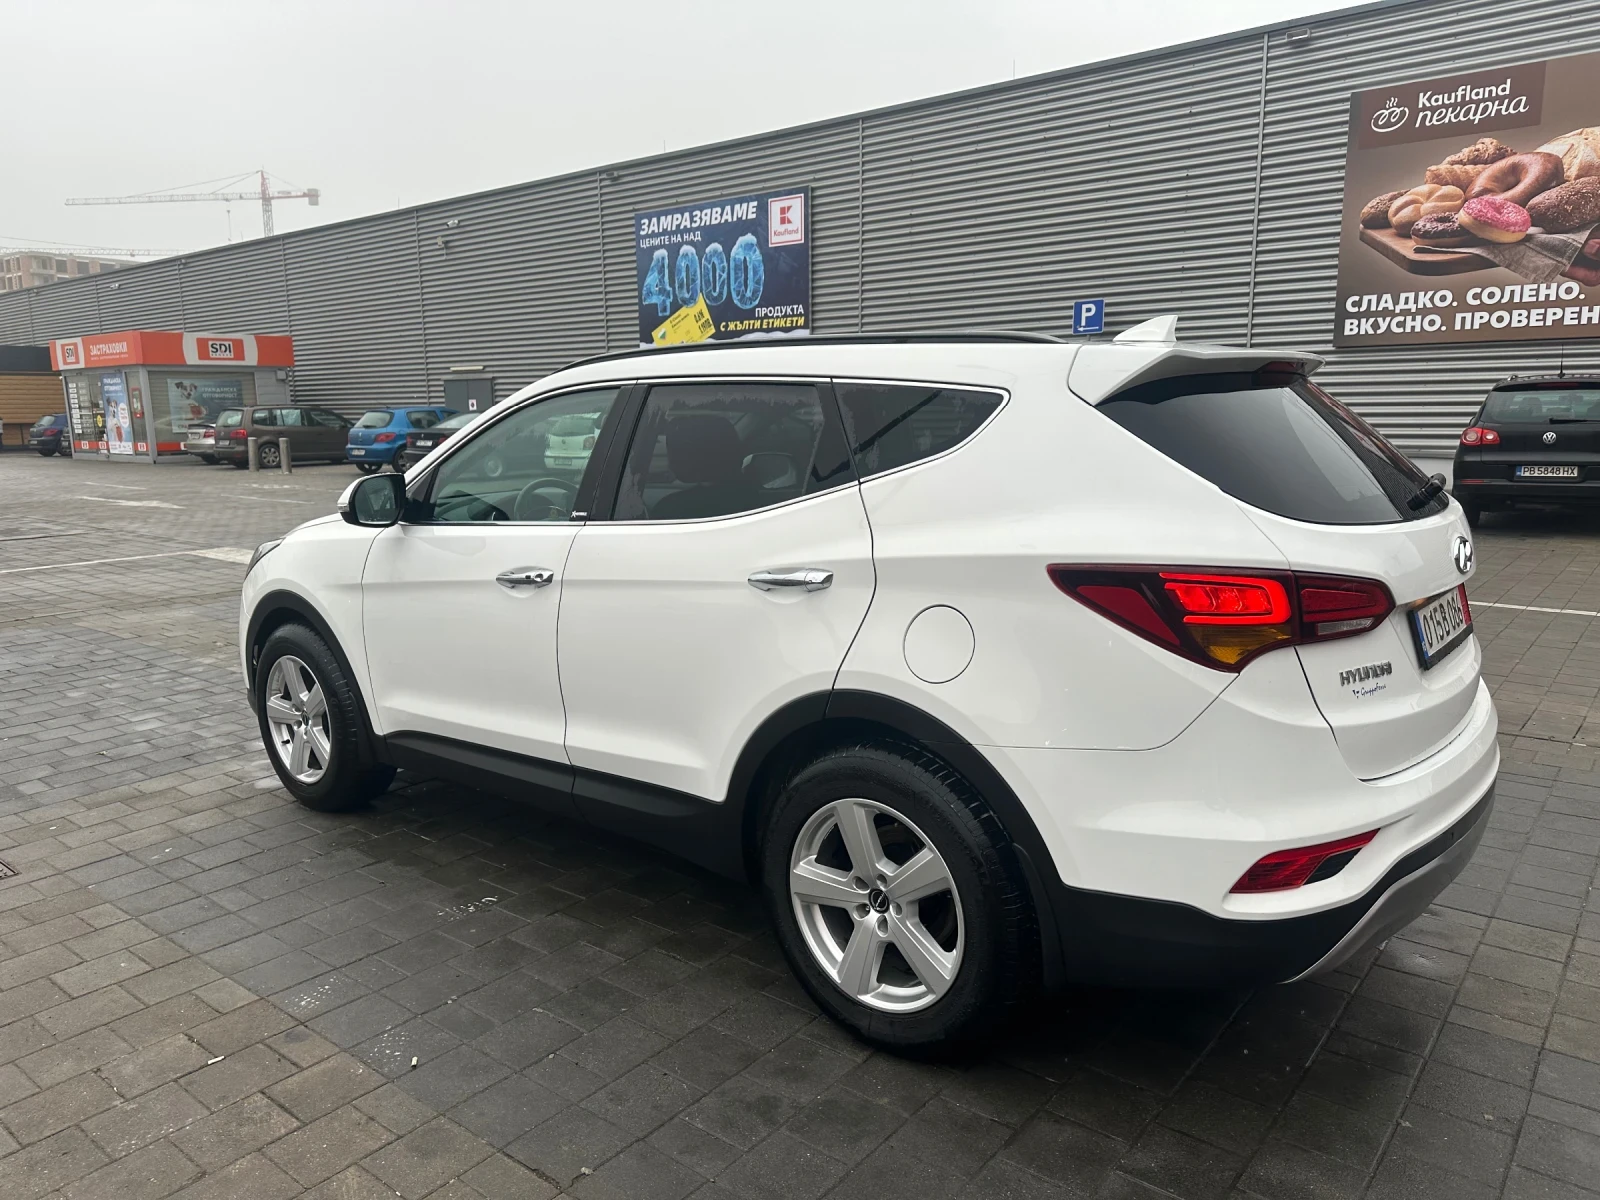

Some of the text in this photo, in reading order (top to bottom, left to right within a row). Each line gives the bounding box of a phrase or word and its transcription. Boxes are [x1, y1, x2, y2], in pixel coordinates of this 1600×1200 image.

[1418, 78, 1511, 108] Kaufland
[1415, 96, 1529, 128] пекарна
[640, 201, 758, 235] ЗАМРАЗЯВАМЕ
[640, 231, 702, 248] ЦЕНИТЕ НА НАД
[773, 227, 800, 237] Kaufland
[642, 233, 765, 316] 4000
[1345, 281, 1586, 313] СЛАДКО. СОЛЕНО.
[755, 304, 804, 318] ПРОДУКТА
[1081, 303, 1096, 326] P
[720, 321, 727, 332] С
[727, 319, 761, 331] ЖЪЛТИ
[762, 316, 805, 329] ЕТИКЕТИ
[1343, 314, 1447, 336] ВКУСНО.
[89, 341, 128, 355] ЗАСТРАХОВКИ
[210, 342, 232, 354] SDI
[1522, 466, 1576, 476] PB 5848 HX
[1339, 660, 1393, 687] HYUNDAI
